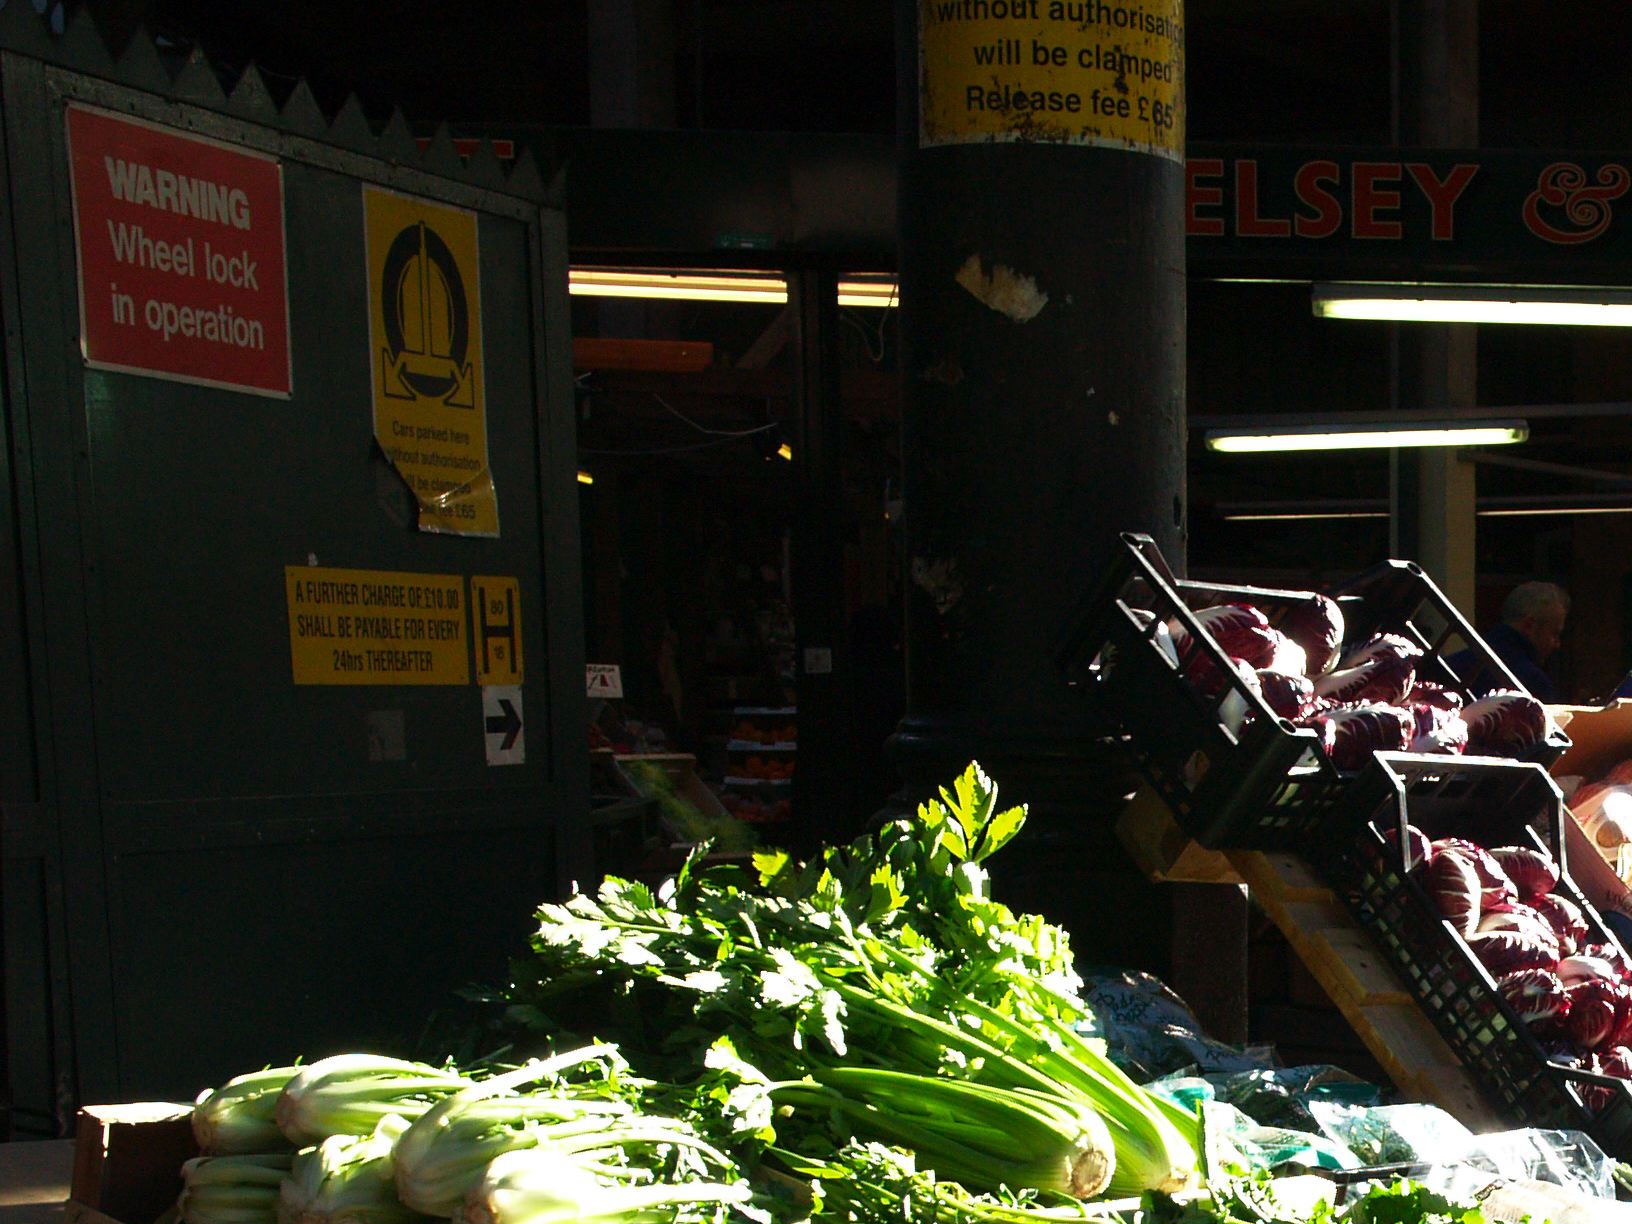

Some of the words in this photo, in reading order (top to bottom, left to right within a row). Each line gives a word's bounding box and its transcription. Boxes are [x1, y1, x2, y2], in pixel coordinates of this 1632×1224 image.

[974, 39, 1021, 66] will
[1032, 40, 1067, 66] be
[1077, 44, 1172, 83] clamped
[966, 85, 1081, 113] Release
[1092, 89, 1130, 118] fee
[104, 156, 250, 231] WARNING
[1521, 161, 1632, 246] &
[107, 218, 195, 278] Wheel
[204, 242, 259, 292] lock
[110, 283, 134, 325] in
[145, 299, 264, 350] operation
[393, 421, 415, 438] Cars
[416, 424, 449, 443] parked
[450, 428, 471, 446] here
[296, 581, 304, 603] A
[306, 582, 358, 606] FURTHER
[361, 584, 405, 608] CHARGE
[408, 586, 423, 610] OF
[424, 588, 459, 611] £10.00
[298, 615, 335, 638] SHALL
[338, 616, 352, 639] BE
[355, 617, 401, 640] PAYABLE
[404, 619, 425, 641] FOR
[428, 621, 461, 641] EVERY
[333, 650, 364, 672] 24hrs
[366, 651, 433, 673] THEREAFTER
